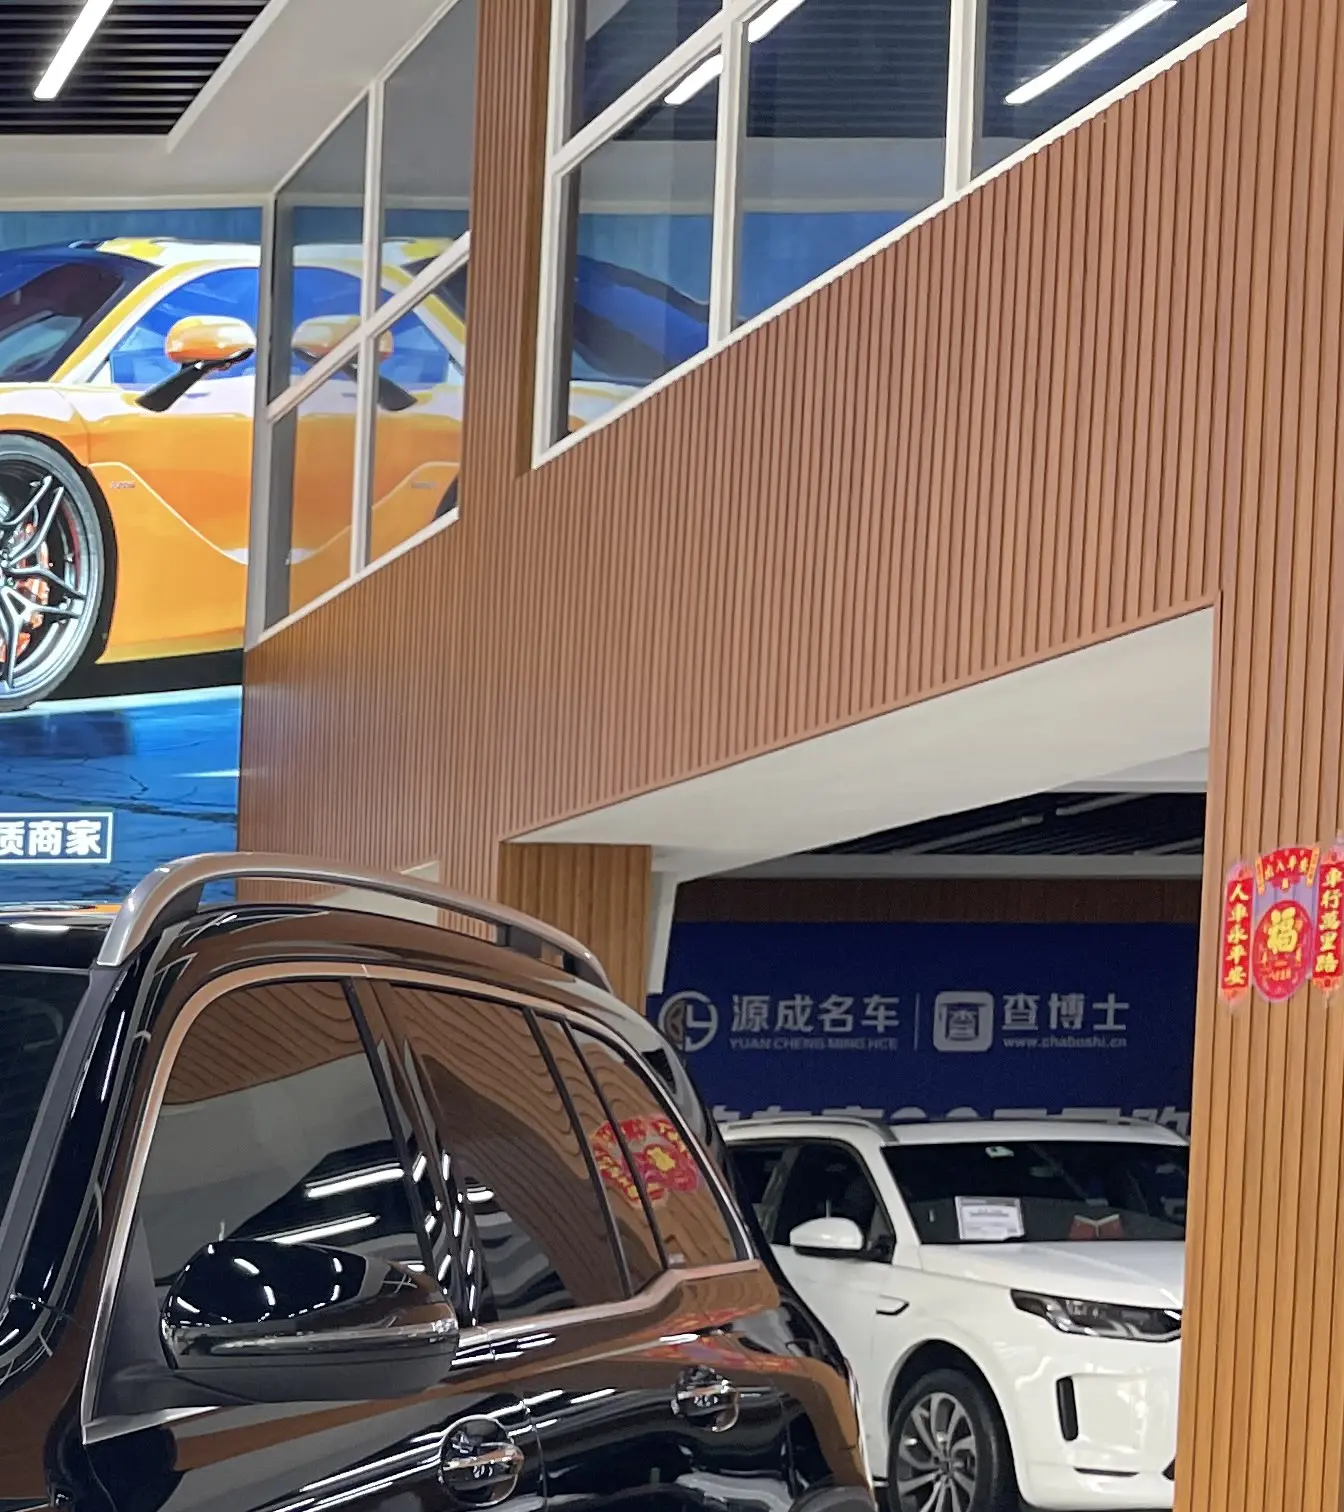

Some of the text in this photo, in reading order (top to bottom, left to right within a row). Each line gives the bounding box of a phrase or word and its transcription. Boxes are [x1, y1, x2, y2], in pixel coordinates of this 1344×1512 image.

[1267, 907, 1297, 955] 福
[731, 994, 900, 1033] 源成名车
[1002, 992, 1130, 1031] 查博士
